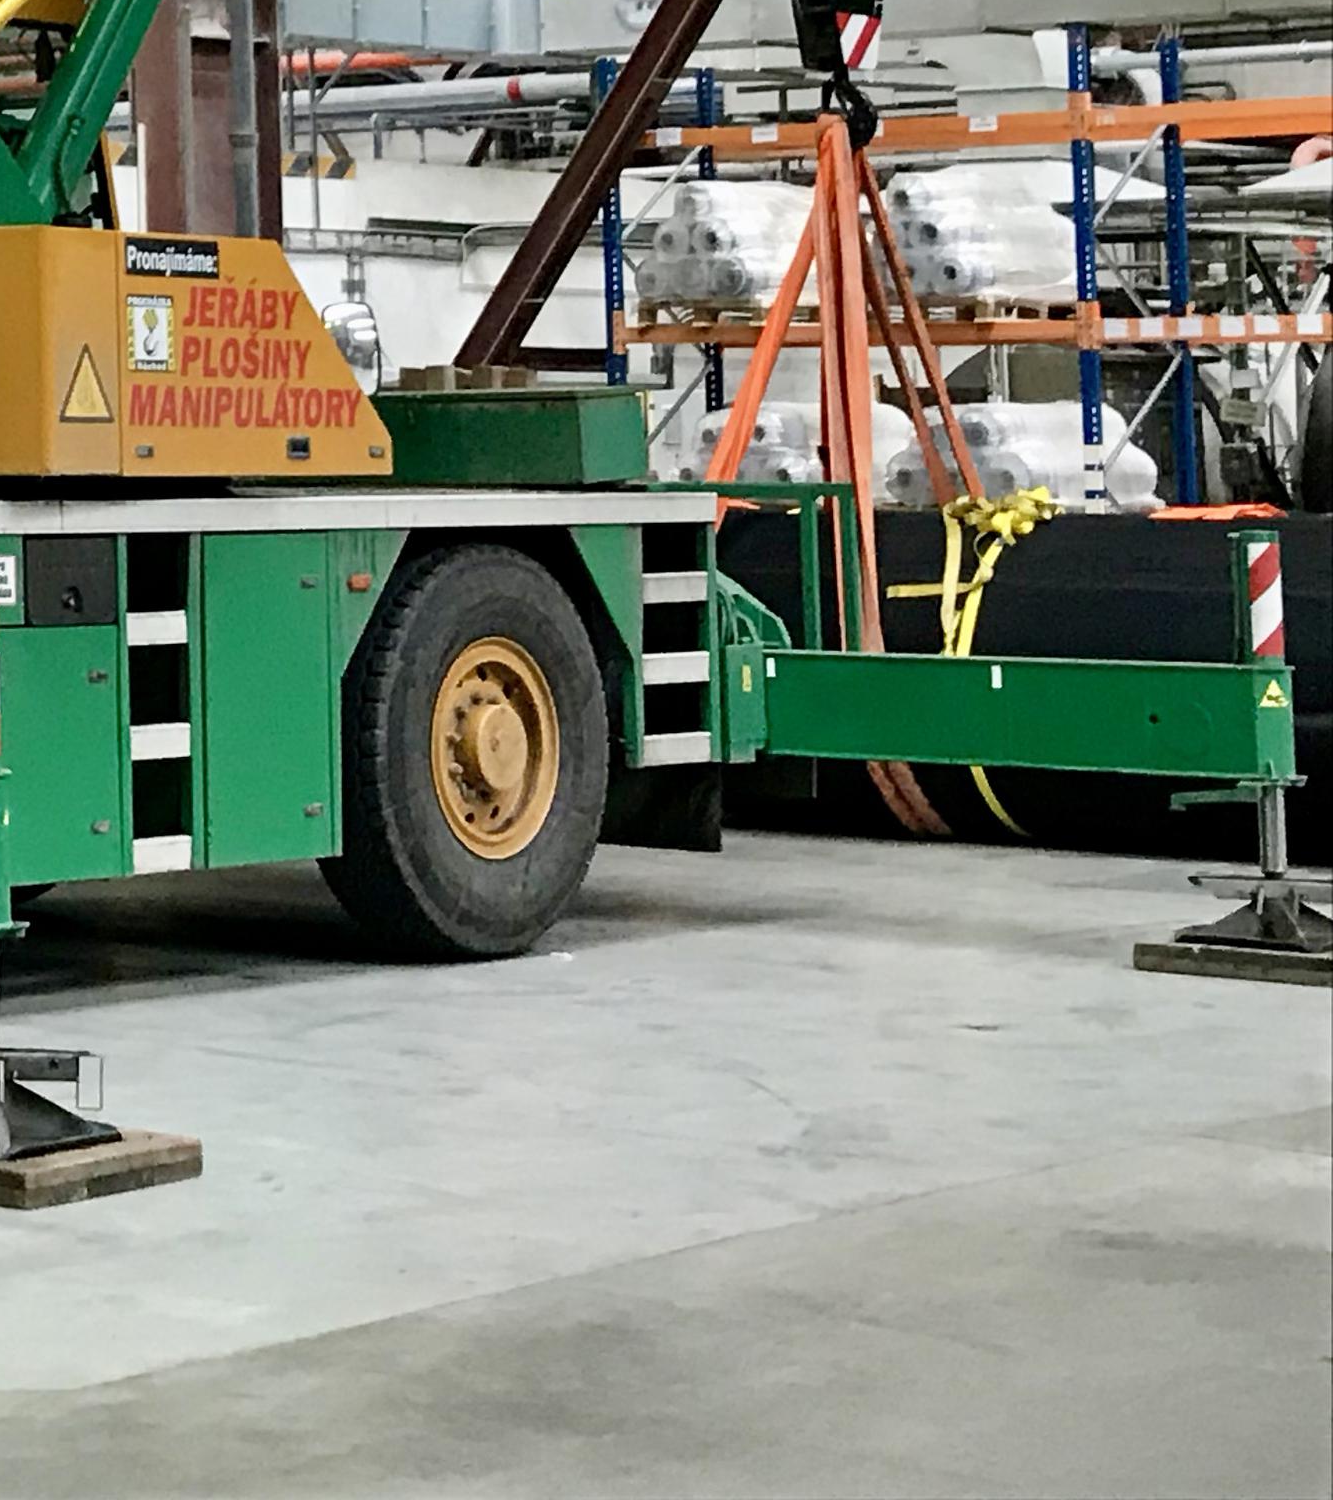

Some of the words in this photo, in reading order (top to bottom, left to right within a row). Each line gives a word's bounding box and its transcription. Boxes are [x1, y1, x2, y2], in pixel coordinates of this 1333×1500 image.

[126, 244, 218, 278] Pronajímáme:
[182, 275, 301, 331] JEŘÁBY
[179, 330, 313, 381] PLOŠINY
[127, 380, 362, 430] MANIPULÁTORY
